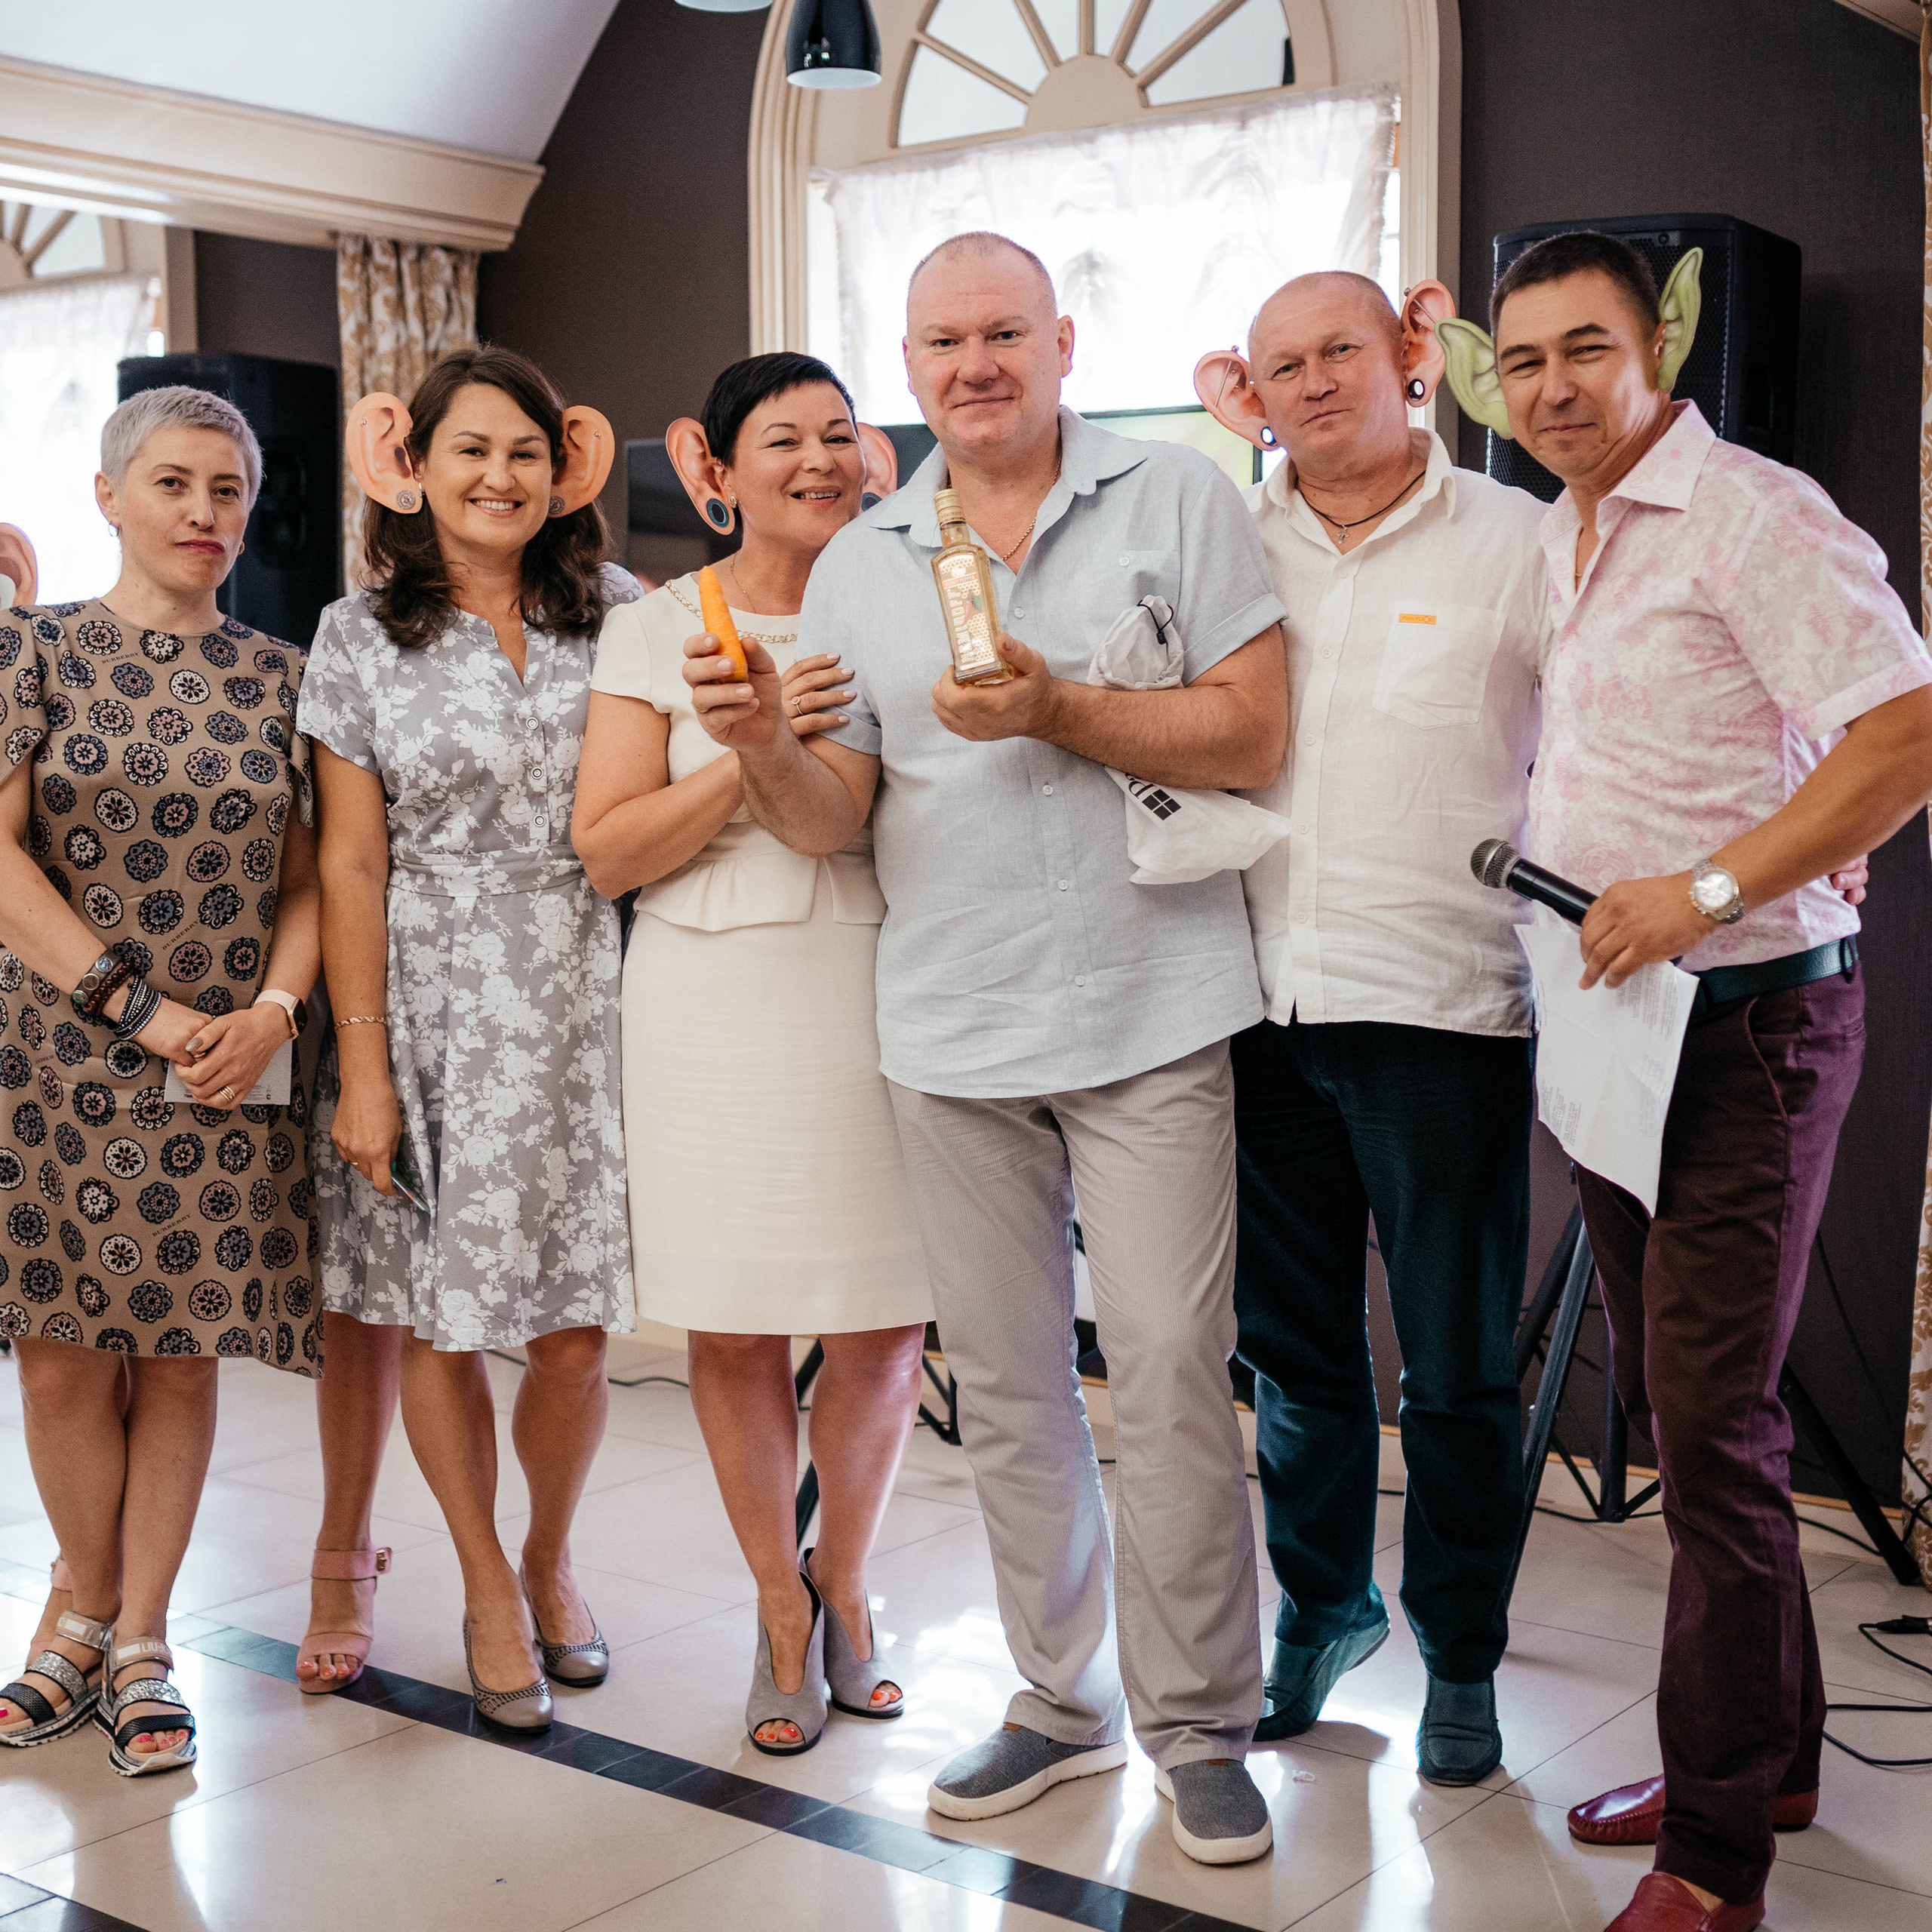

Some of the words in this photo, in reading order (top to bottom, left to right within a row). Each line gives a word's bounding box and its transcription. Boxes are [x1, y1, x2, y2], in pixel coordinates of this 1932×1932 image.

[102, 652, 139, 664] BURBERRY
[162, 921, 198, 950] BURBERRY
[152, 1213, 191, 1237] BURBERRY
